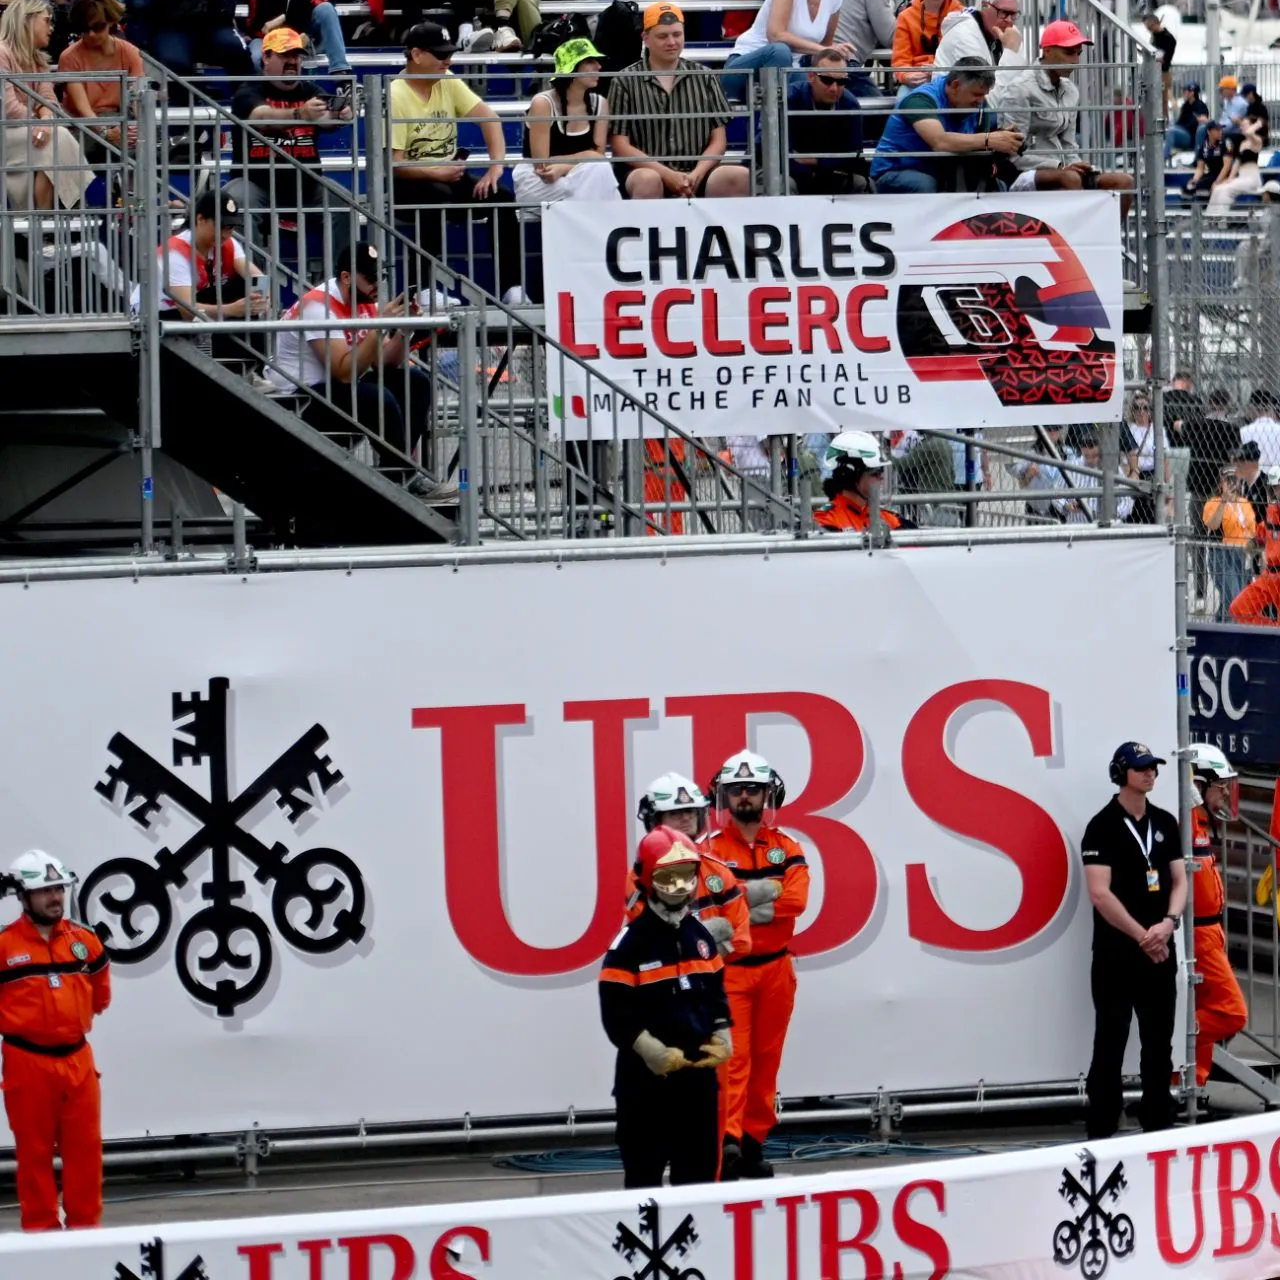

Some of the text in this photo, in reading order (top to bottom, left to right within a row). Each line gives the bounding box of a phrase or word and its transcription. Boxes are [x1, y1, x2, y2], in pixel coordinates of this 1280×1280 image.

[605, 221, 896, 284] CHARLES
[557, 284, 890, 360] LECLERC
[593, 383, 912, 413] MARCHE FAN CLUB
[634, 362, 870, 388] THE OFFICIAL
[1188, 654, 1250, 721] SC
[1189, 731, 1250, 754] UISES
[412, 679, 1070, 977] UBS
